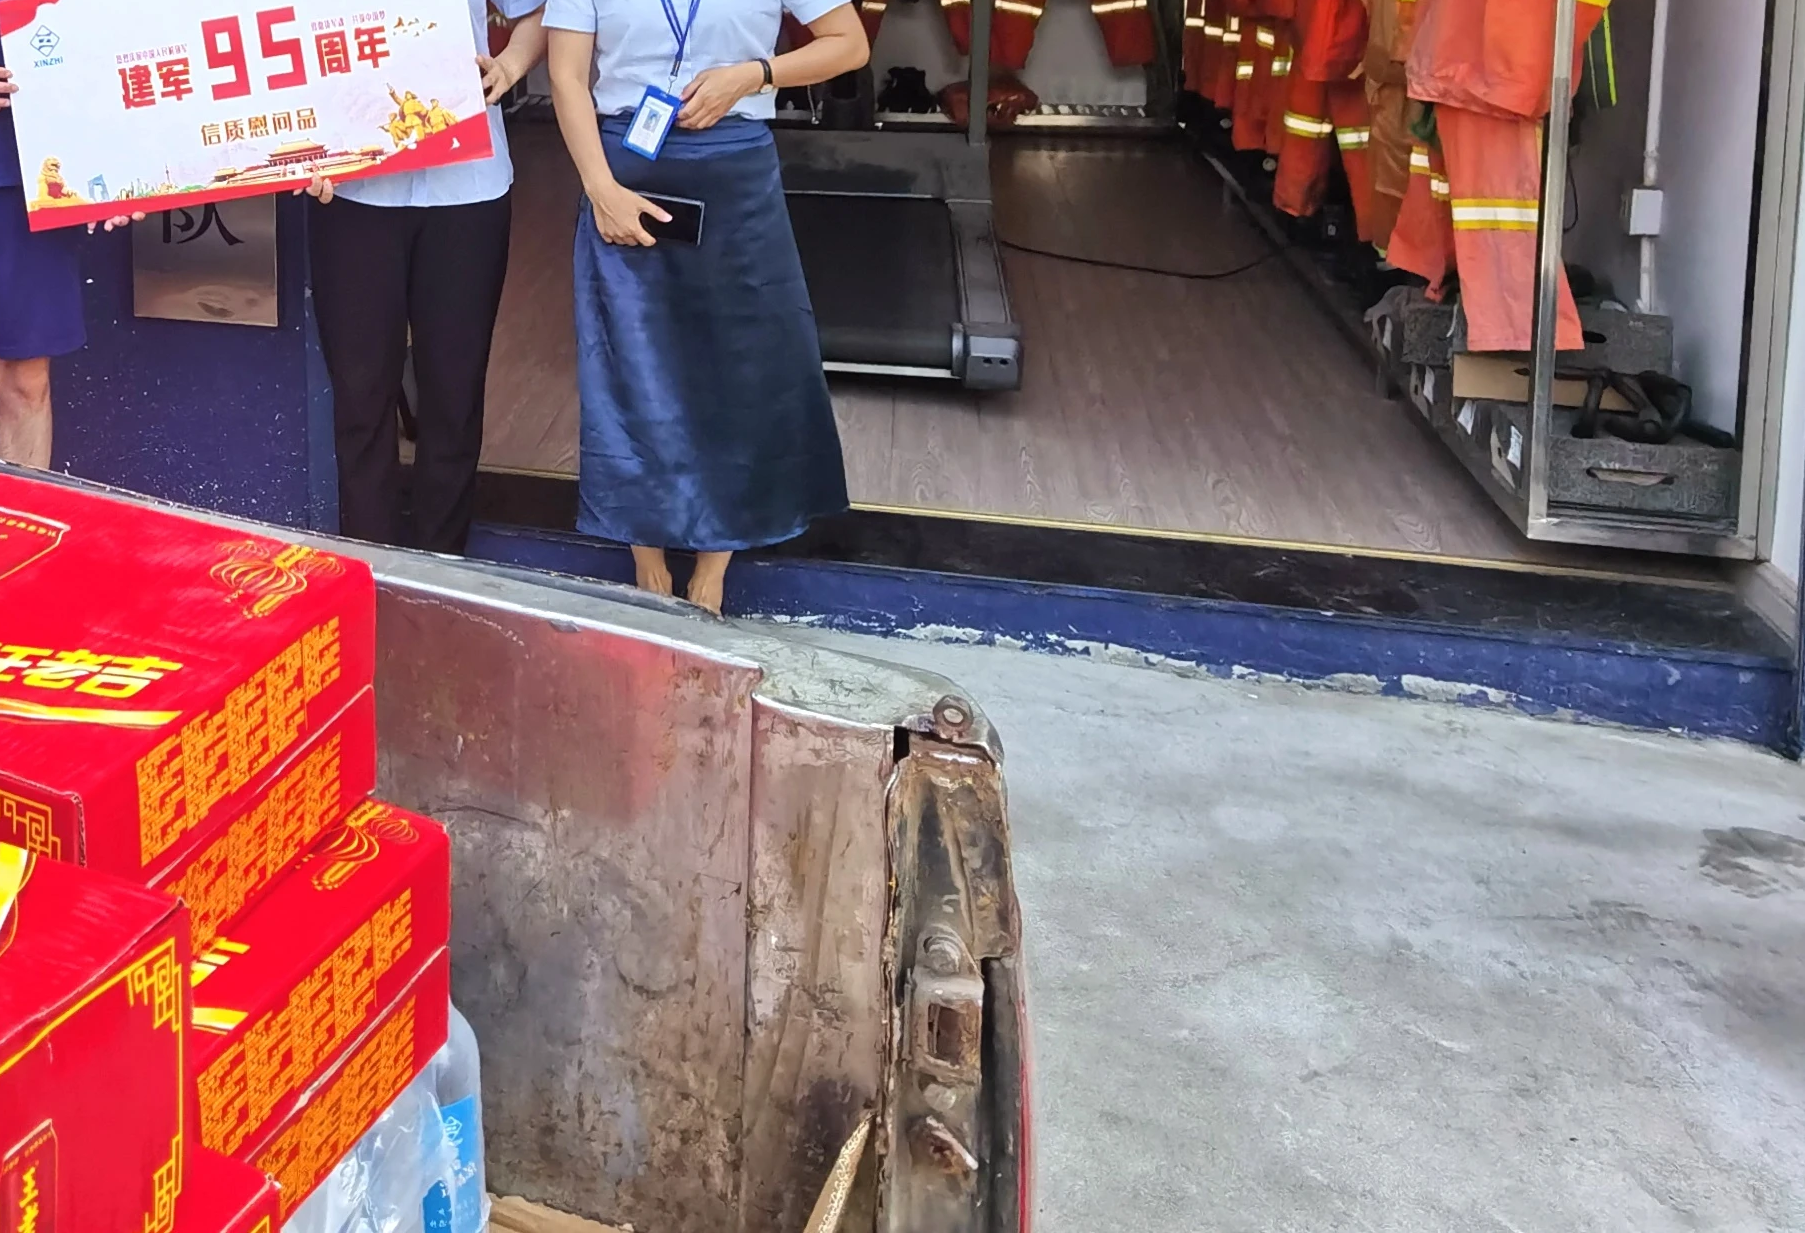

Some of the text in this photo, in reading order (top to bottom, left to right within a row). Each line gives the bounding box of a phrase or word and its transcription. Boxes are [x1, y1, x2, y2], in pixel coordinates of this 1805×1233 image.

[34, 55, 65, 69] XINZHI
[200, 107, 319, 148] 信质慰问品
